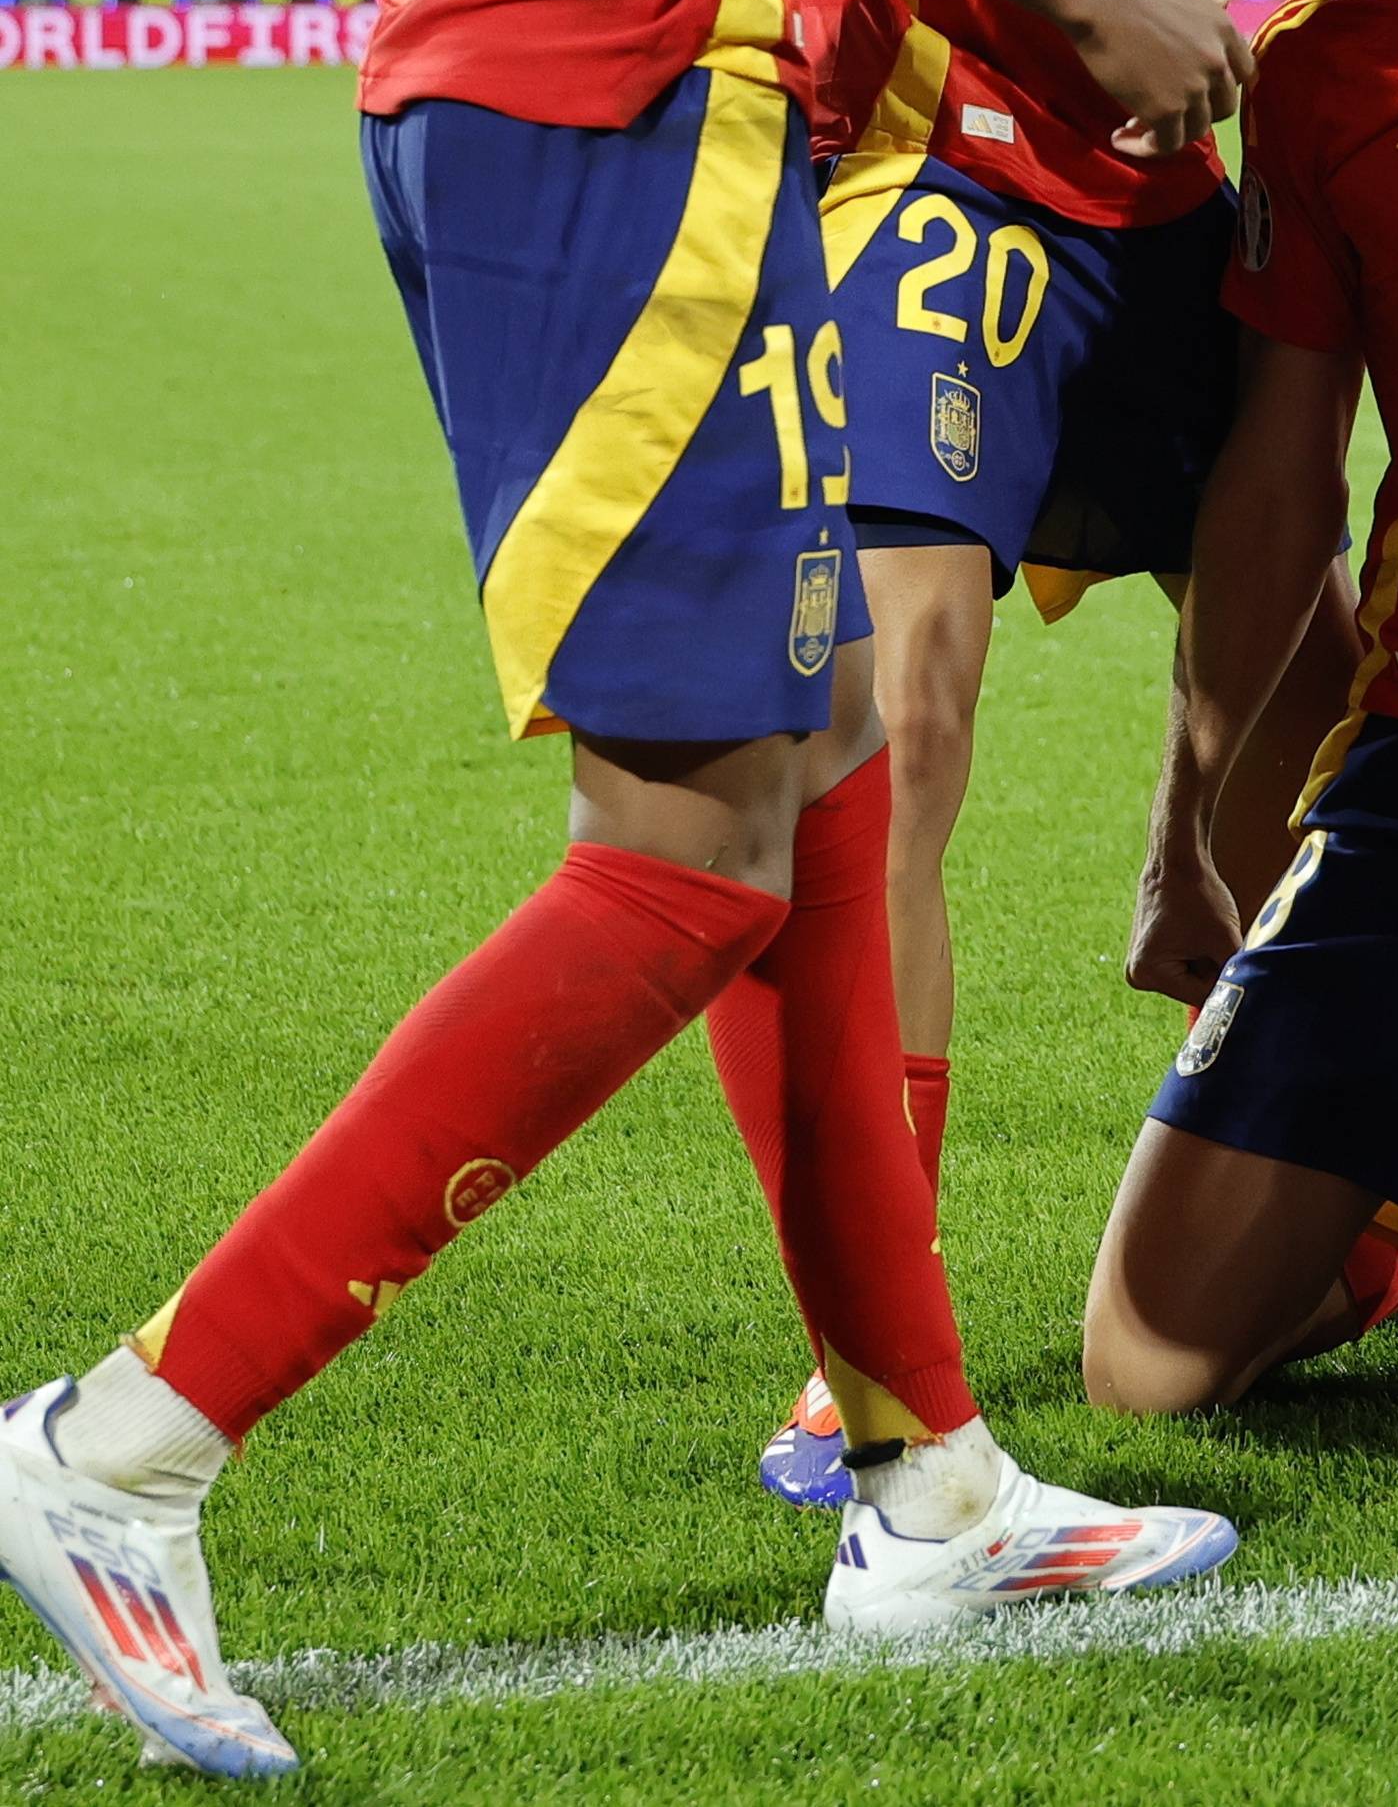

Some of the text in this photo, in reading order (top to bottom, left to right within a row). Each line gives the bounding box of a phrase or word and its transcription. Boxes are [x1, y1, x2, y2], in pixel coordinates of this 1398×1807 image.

[897, 193, 1051, 368] 20
[738, 319, 849, 510] 19
[1243, 829, 1329, 952] 8
